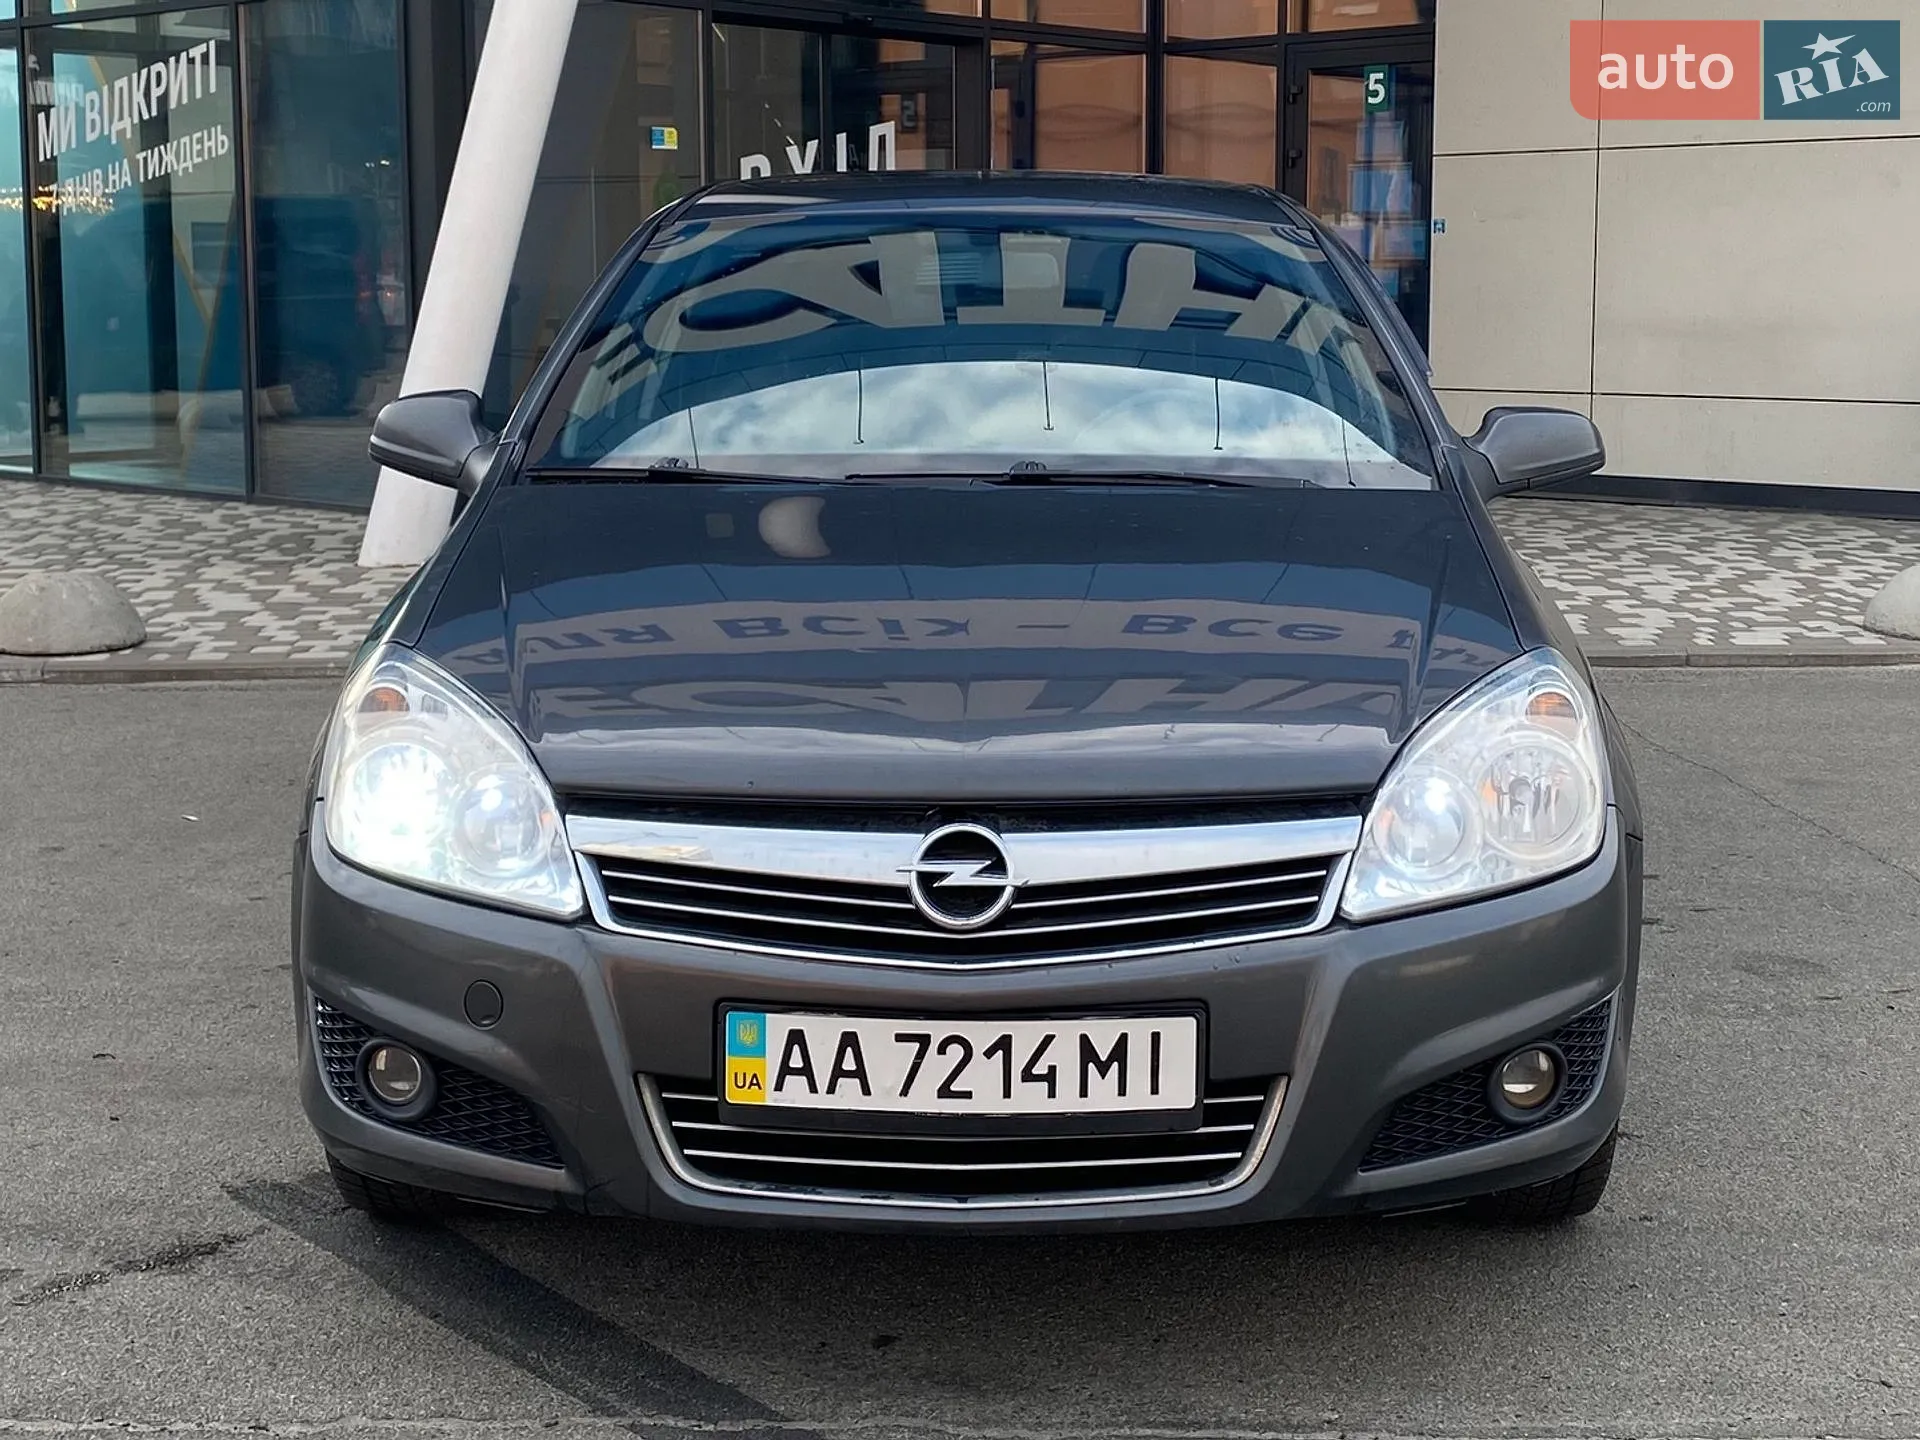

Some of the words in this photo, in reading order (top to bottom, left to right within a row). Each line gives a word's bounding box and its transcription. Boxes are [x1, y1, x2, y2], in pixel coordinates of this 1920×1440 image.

[37, 101, 77, 163] МИ
[84, 39, 217, 145] ВІДКРИТІ
[1367, 72, 1386, 105] 5
[107, 157, 132, 194] НА
[136, 124, 230, 184] ТИЖДЕНЬ
[733, 1072, 763, 1091] UA
[773, 1029, 872, 1097] AA
[893, 1032, 1058, 1100] 7214
[1078, 1031, 1162, 1099] MI
